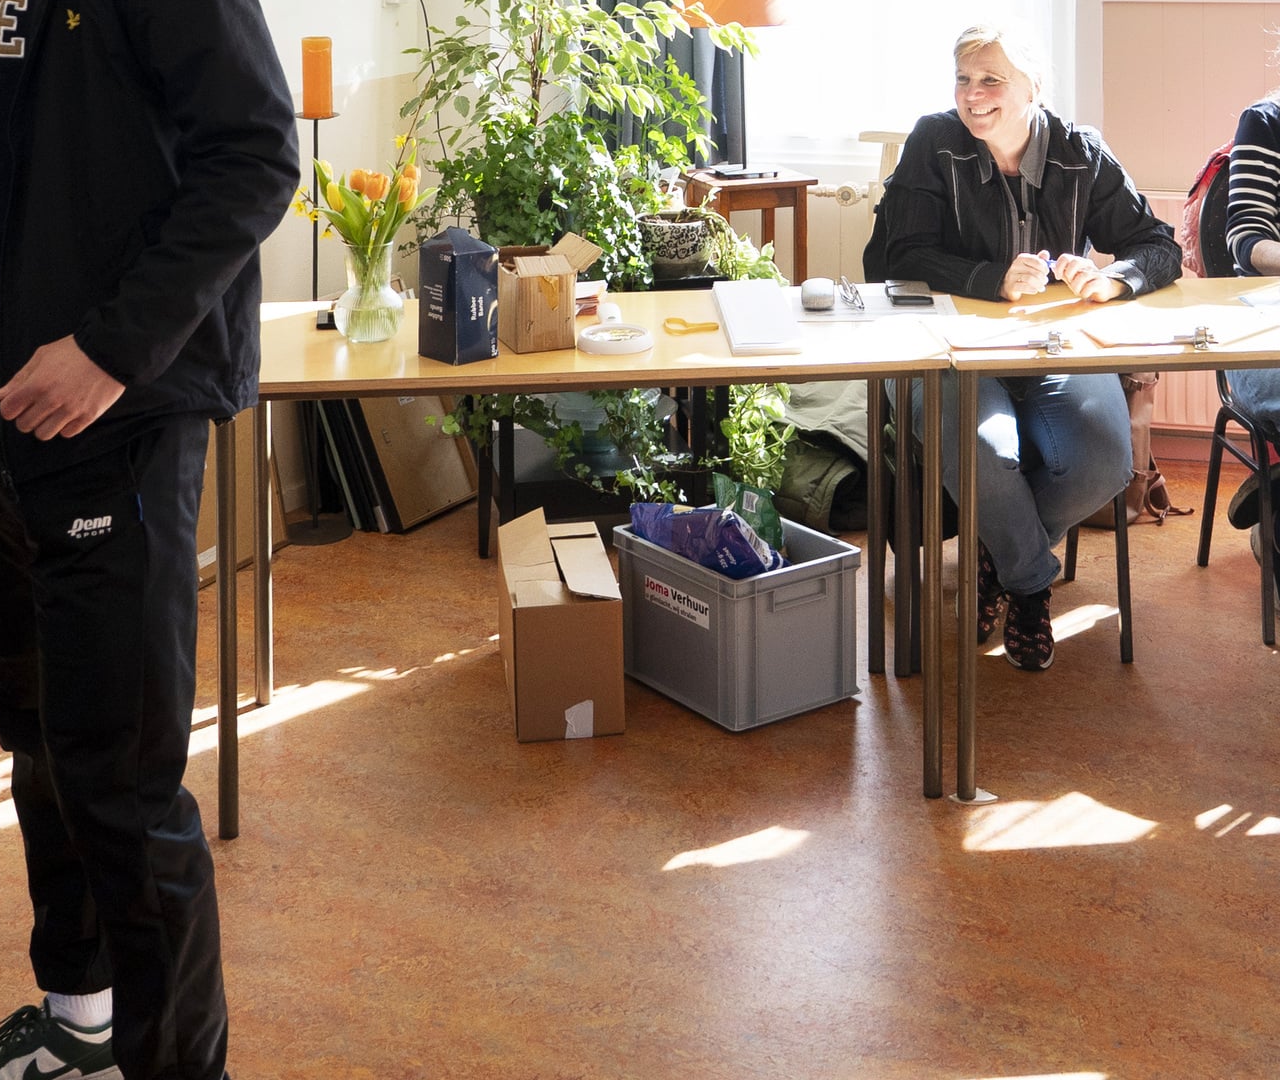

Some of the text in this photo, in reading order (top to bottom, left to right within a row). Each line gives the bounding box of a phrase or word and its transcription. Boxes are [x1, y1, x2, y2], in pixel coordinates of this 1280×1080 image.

[67, 515, 112, 537] Penn
[646, 577, 709, 617] Joma Verhuur
